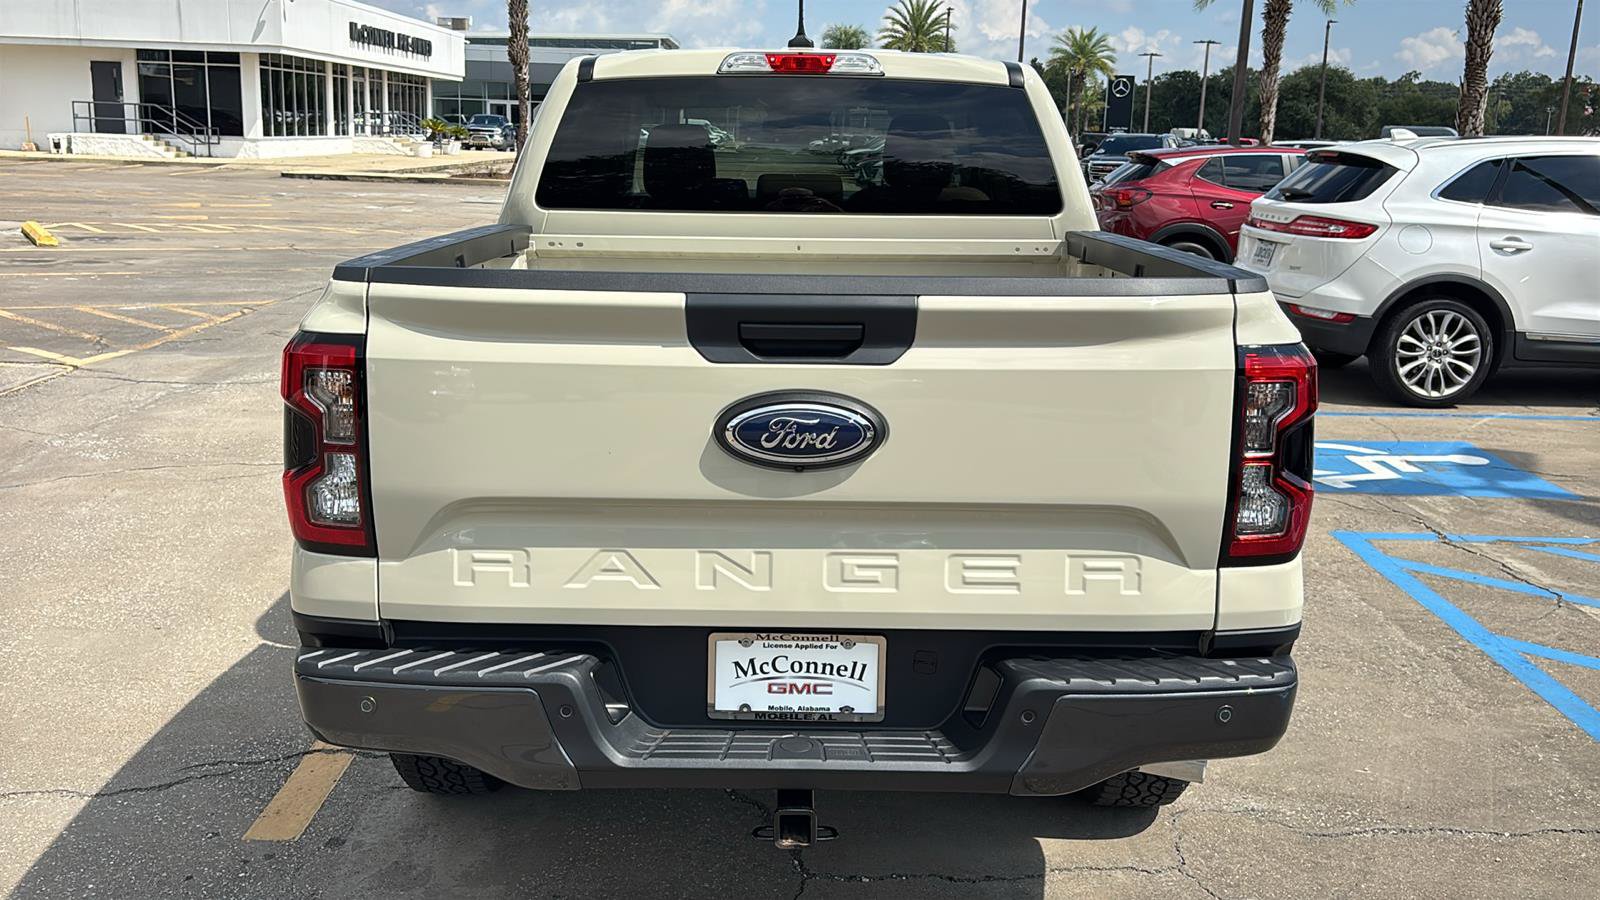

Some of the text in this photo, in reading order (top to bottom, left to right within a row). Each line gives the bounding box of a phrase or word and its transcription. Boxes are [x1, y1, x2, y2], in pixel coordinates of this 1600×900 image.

[760, 416, 839, 449] Ford
[452, 547, 1143, 596] RANGER
[755, 633, 840, 642] McConnell
[795, 643, 823, 651] Applied
[732, 655, 868, 682] McConnell
[767, 683, 833, 695] GMC
[767, 705, 796, 713] Mobile,
